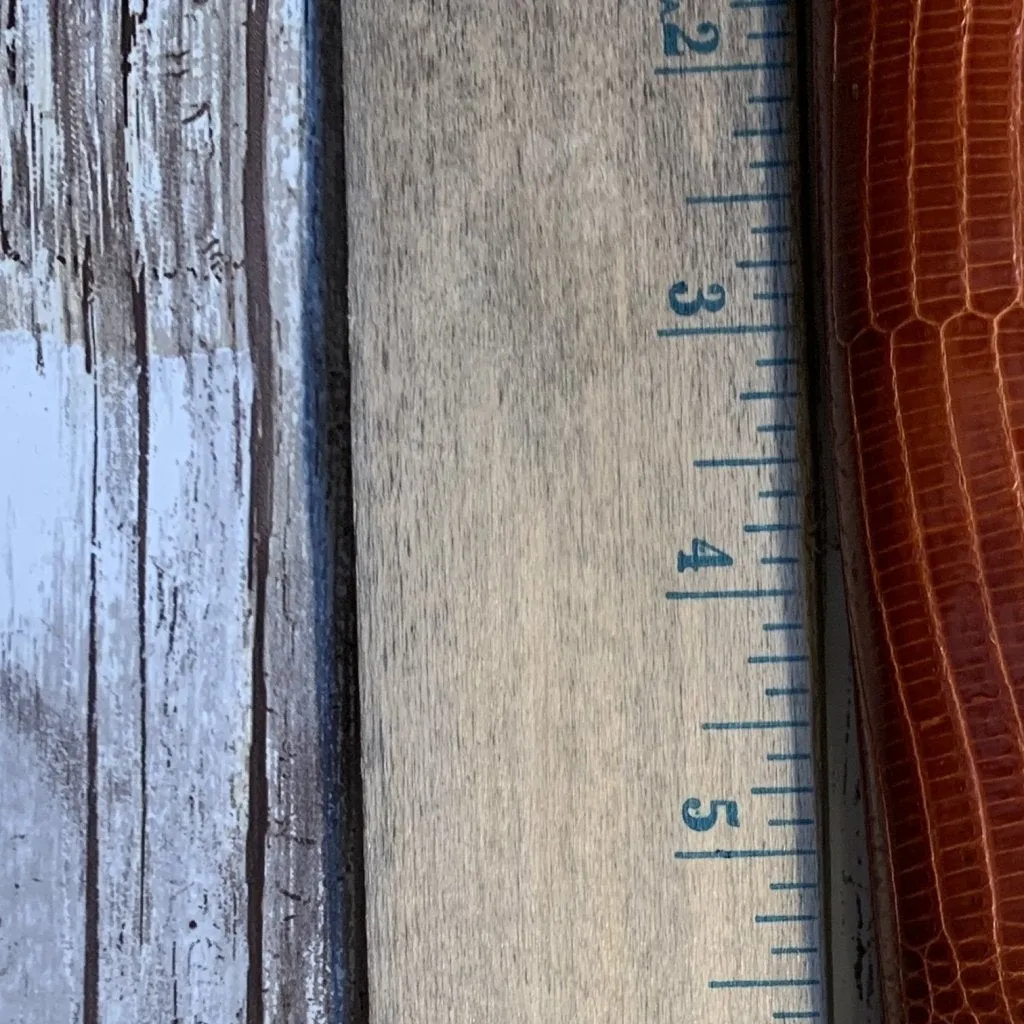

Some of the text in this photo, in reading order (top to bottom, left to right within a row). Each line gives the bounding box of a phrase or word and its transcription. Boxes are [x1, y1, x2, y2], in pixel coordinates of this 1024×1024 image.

[664, 21, 720, 56] 2
[668, 281, 726, 315] 3
[677, 538, 733, 573] 4
[682, 797, 740, 832] 5
